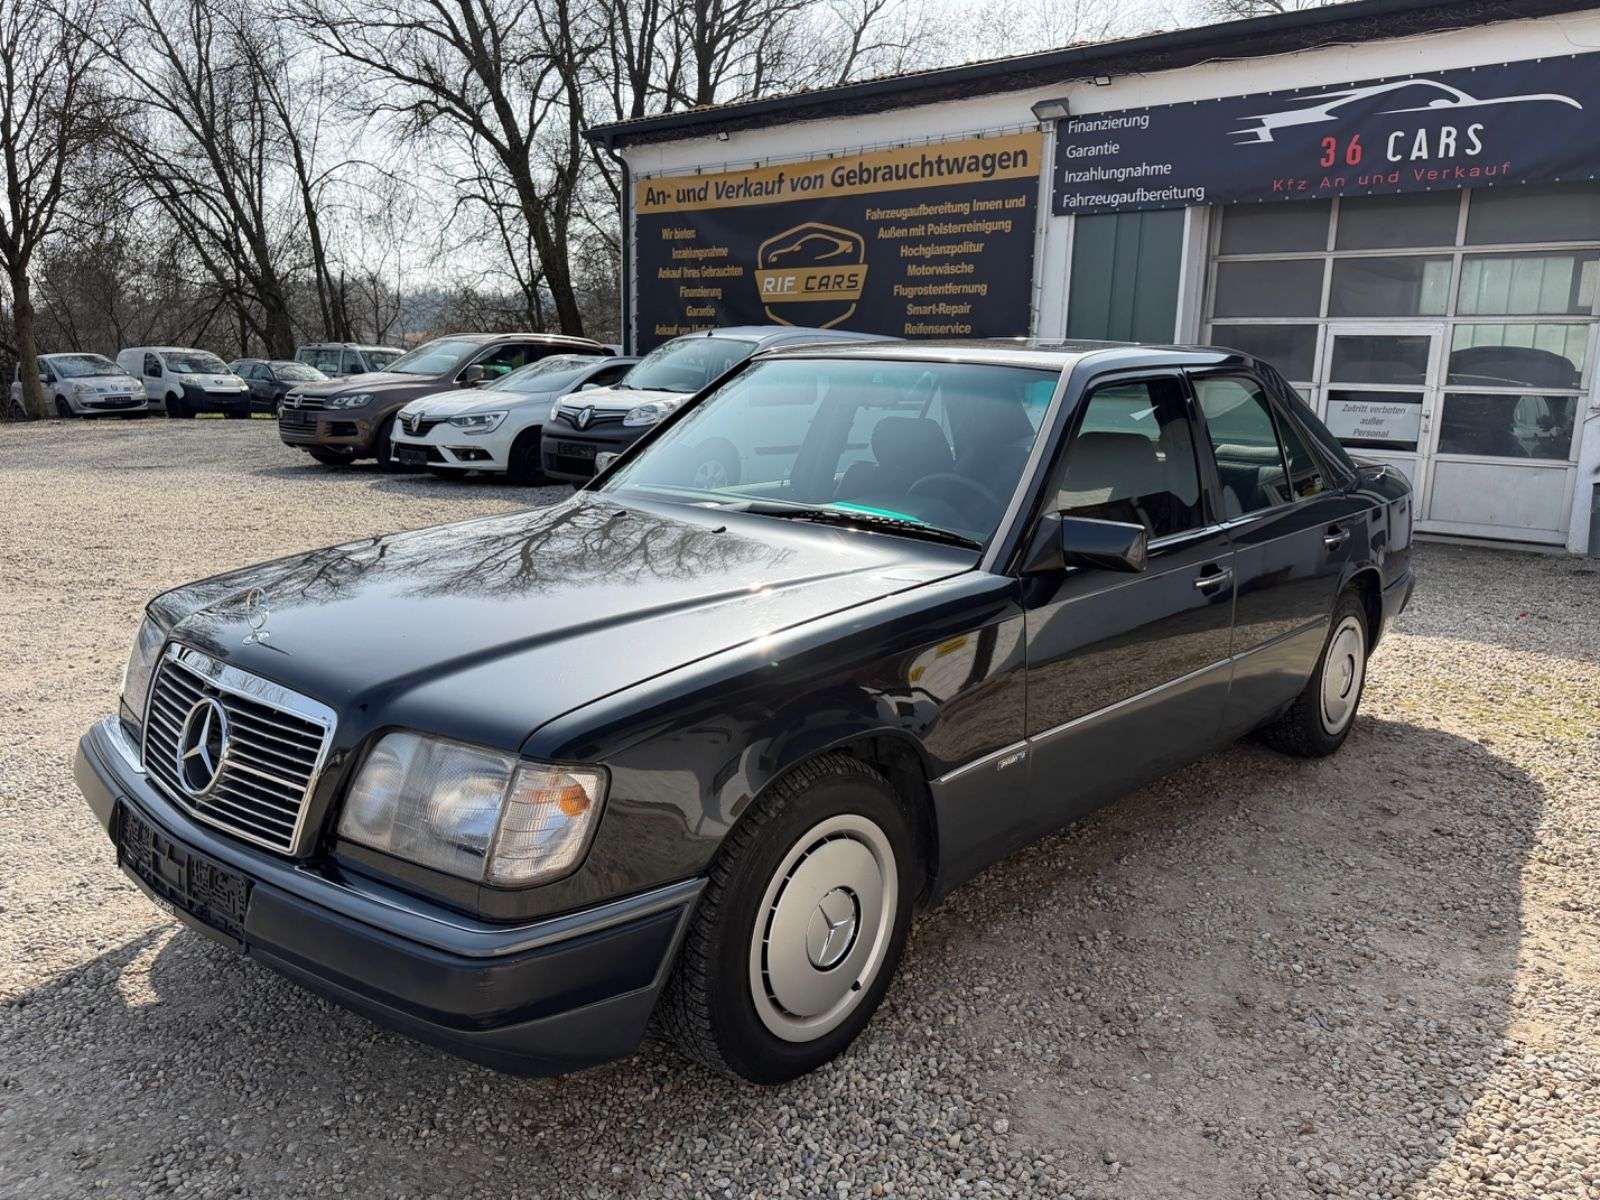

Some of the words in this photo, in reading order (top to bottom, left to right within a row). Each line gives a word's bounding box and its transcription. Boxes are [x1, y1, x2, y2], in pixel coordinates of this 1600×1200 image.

[1068, 115, 1150, 134] Finanzierung
[1066, 140, 1120, 158] Garantie
[1319, 134, 1363, 168] 36
[1386, 123, 1484, 162] CARS
[644, 187, 671, 206] An-
[676, 181, 709, 203] und
[715, 172, 785, 200] Verkauf
[790, 174, 824, 192] von
[831, 149, 1029, 188] Gebrauchtwagen
[1064, 162, 1172, 183] Inzahlungnahme
[1273, 179, 1307, 192] Kfz
[1320, 176, 1345, 189] An
[1358, 170, 1400, 186] und
[1412, 161, 1511, 181] Verkauf
[1062, 185, 1206, 208] Fahrzeugaufbereitung
[865, 200, 970, 221] Fahrzeugaufbereitung
[972, 199, 1001, 212] Innen
[1004, 195, 1026, 208] und
[878, 225, 908, 240] Außen
[909, 224, 926, 237] mit
[927, 219, 1012, 235] Polsterreinigung
[900, 242, 985, 258] Hochglanzpolitur
[907, 262, 975, 276] Motorwäsche
[763, 276, 797, 292] RIF
[804, 273, 858, 291] CARS
[893, 283, 988, 298] Flugrostentfernung
[906, 303, 972, 316] Smart-Repair
[904, 322, 972, 335] Reifenservice
[1342, 403, 1367, 413] Zutritt
[1370, 406, 1406, 415] verboten
[1360, 418, 1385, 426] außer
[1353, 428, 1390, 438] Personal
